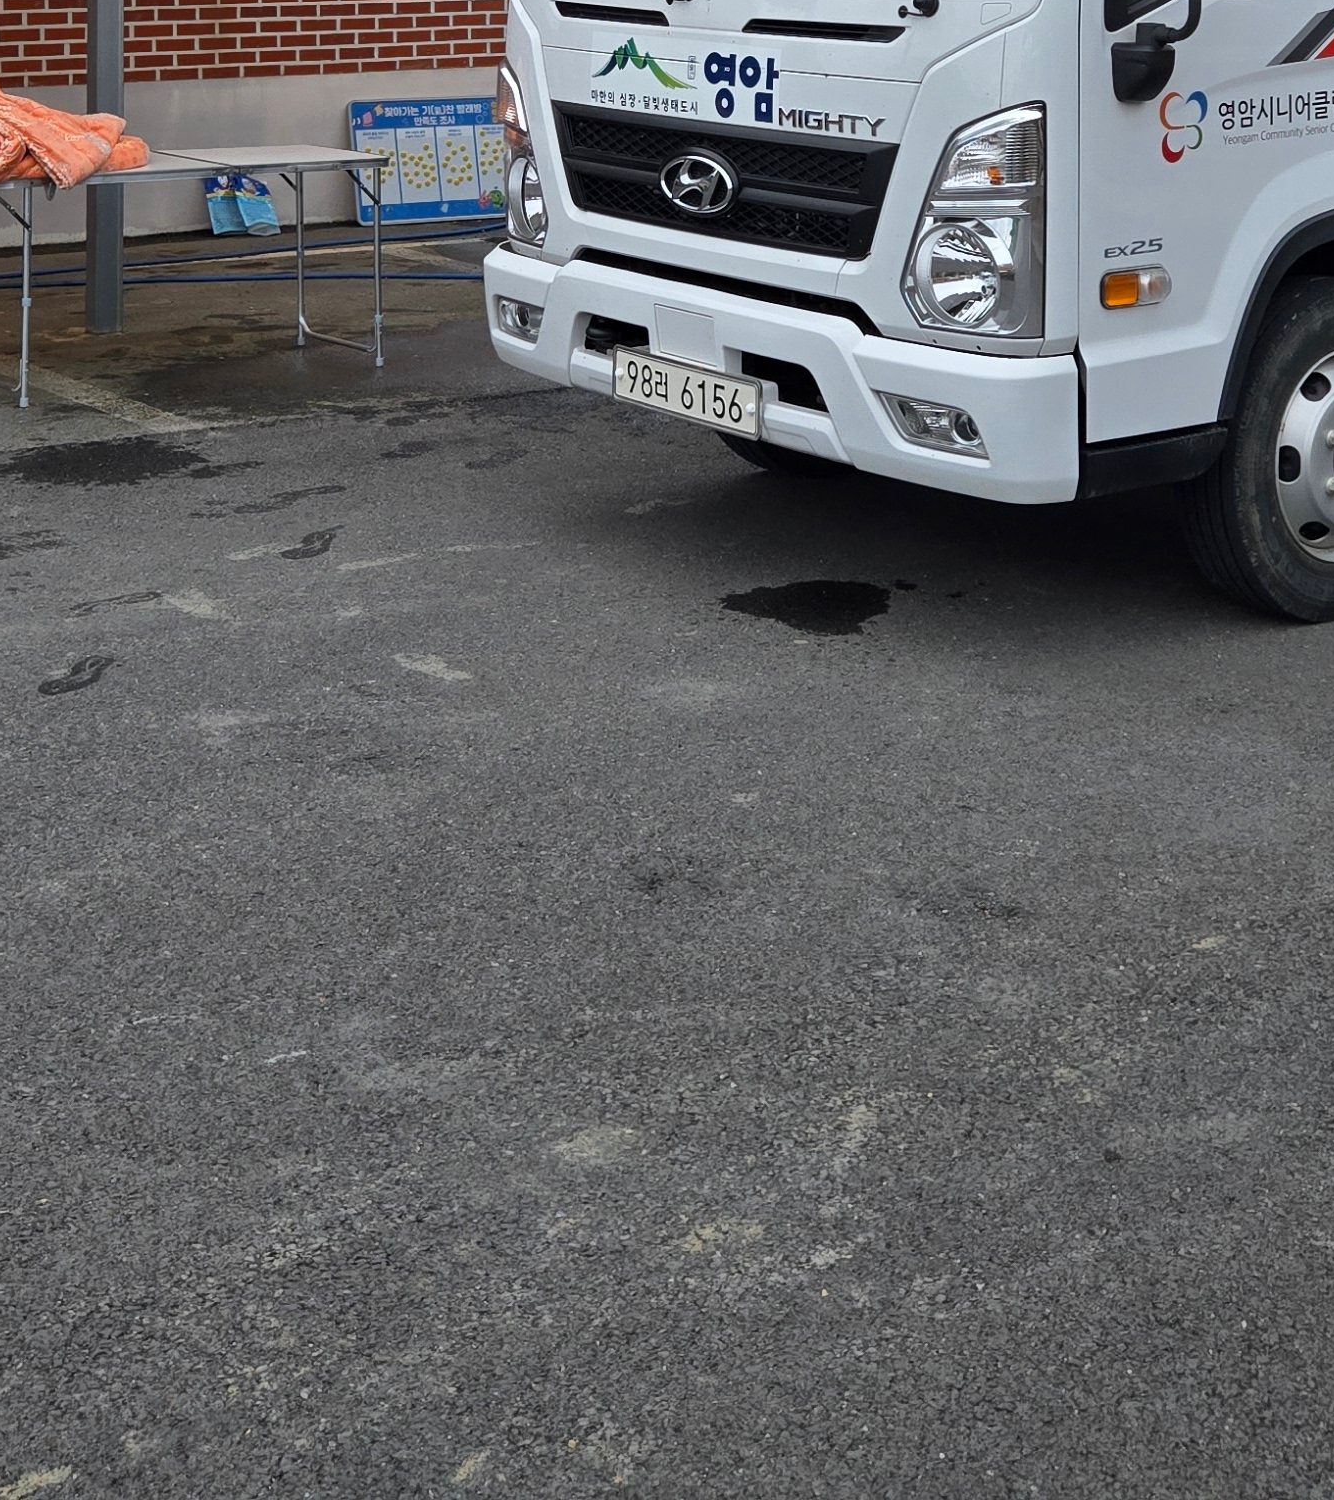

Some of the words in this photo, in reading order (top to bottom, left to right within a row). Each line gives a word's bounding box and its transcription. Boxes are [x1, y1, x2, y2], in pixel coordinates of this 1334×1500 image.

[590, 89, 615, 105] 마한의
[703, 51, 779, 123] 영암
[384, 104, 420, 118] 찾아가는
[777, 106, 886, 137] MIGHTY
[1223, 132, 1260, 146] Yeongam
[1260, 126, 1304, 141] Community
[1304, 122, 1329, 136] Senior
[1104, 238, 1163, 259] EX25
[627, 360, 669, 403] 98러
[681, 375, 743, 424] 6156
